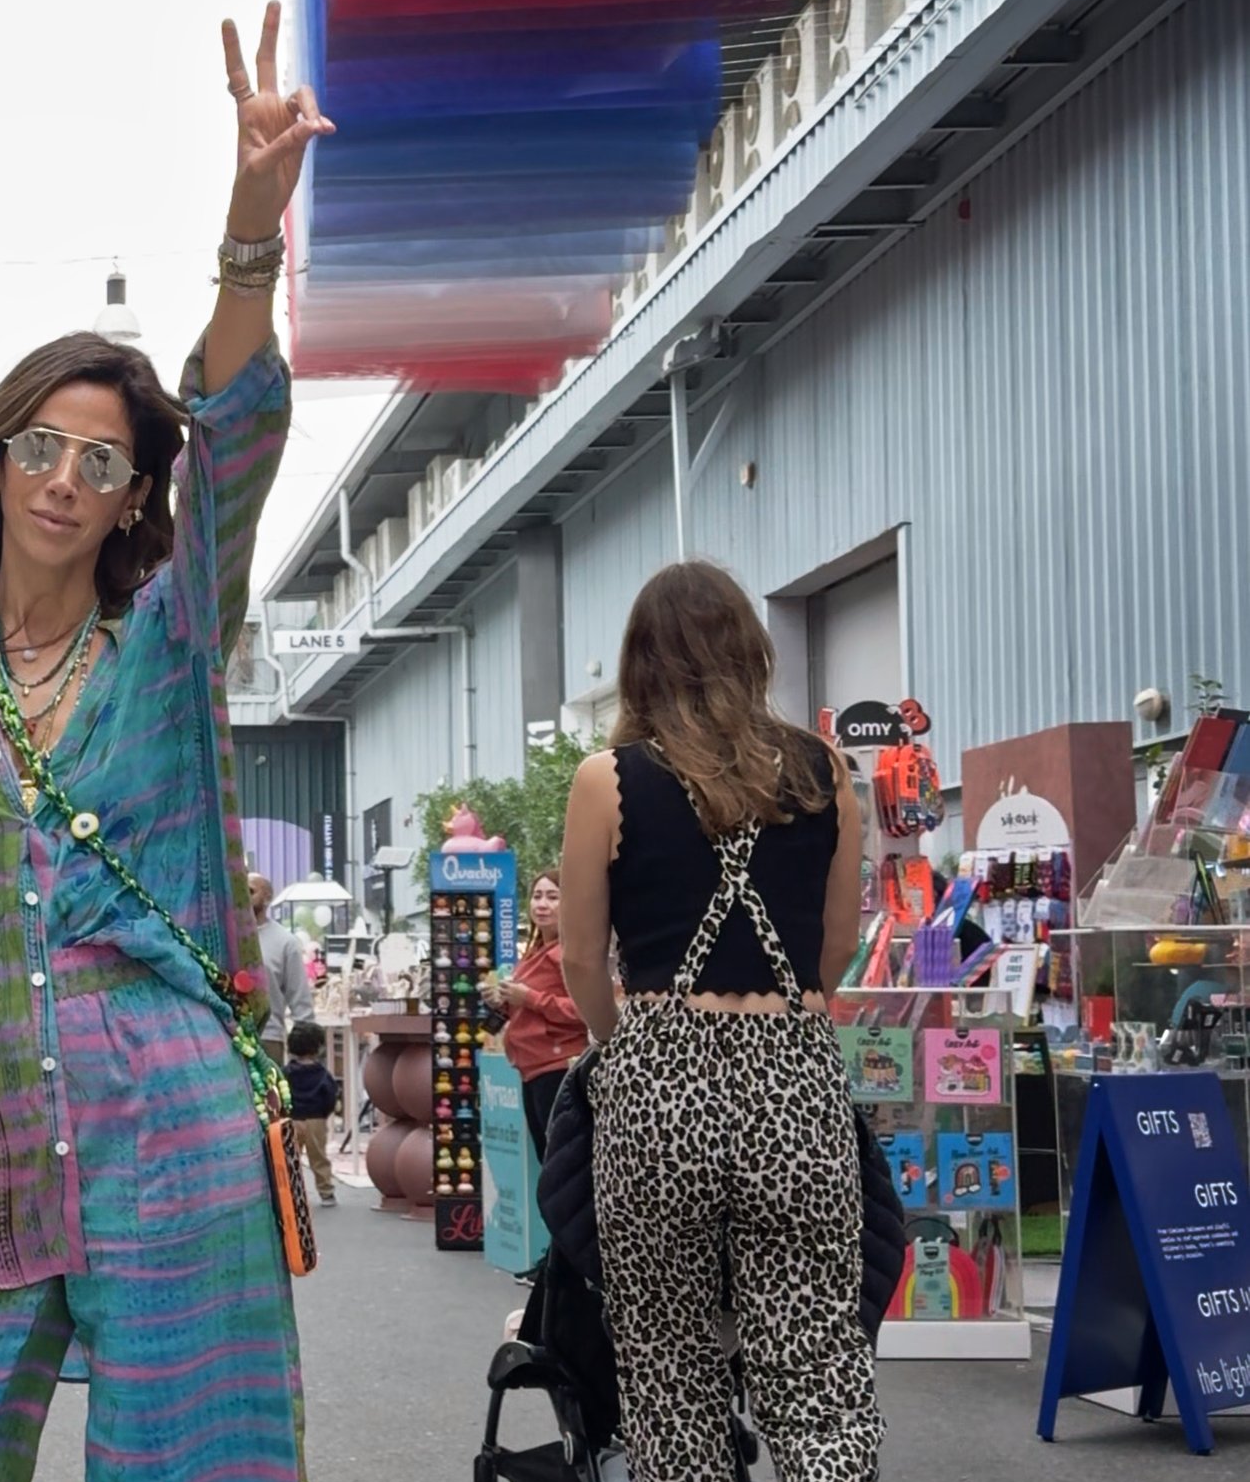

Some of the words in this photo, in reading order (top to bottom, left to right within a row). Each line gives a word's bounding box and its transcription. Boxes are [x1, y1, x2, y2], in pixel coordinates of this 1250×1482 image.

[290, 635, 332, 648] LANE
[336, 635, 345, 648] 5
[499, 899, 514, 958] RUBBER
[1137, 1110, 1180, 1135] GIFTS
[1194, 1181, 1238, 1208] GIFTS
[1197, 1288, 1240, 1317] GIFTS
[1196, 1361, 1223, 1395] the
